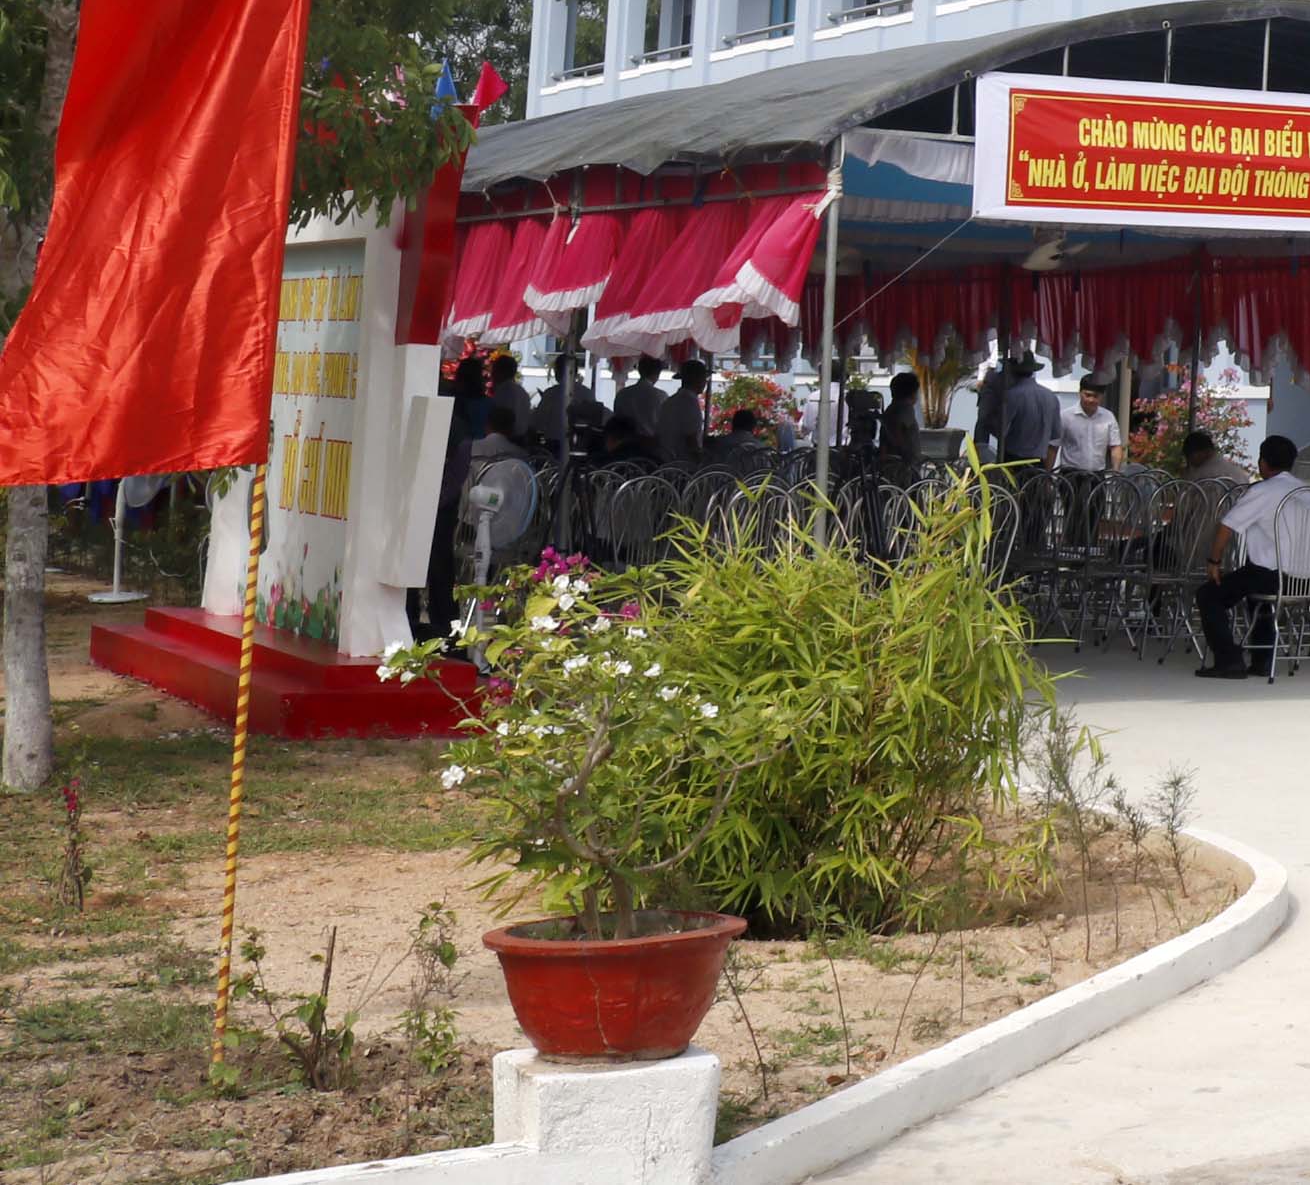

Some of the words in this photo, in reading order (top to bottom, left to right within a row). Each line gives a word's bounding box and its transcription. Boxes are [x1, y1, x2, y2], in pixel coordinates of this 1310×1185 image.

[1079, 114, 1127, 148] CHÀO
[1133, 117, 1186, 151] MỪNG
[1191, 120, 1225, 153] CÁC
[1231, 128, 1259, 161] ĐẠI
[1265, 120, 1302, 158] BIỂU
[1072, 152, 1089, 192] Ở,
[1095, 157, 1135, 190] LÀM
[1141, 160, 1179, 198] VIỆC
[1184, 167, 1215, 200] ĐẠI
[1219, 164, 1249, 201] ĐỘI
[1255, 166, 1310, 198] THÔNG
